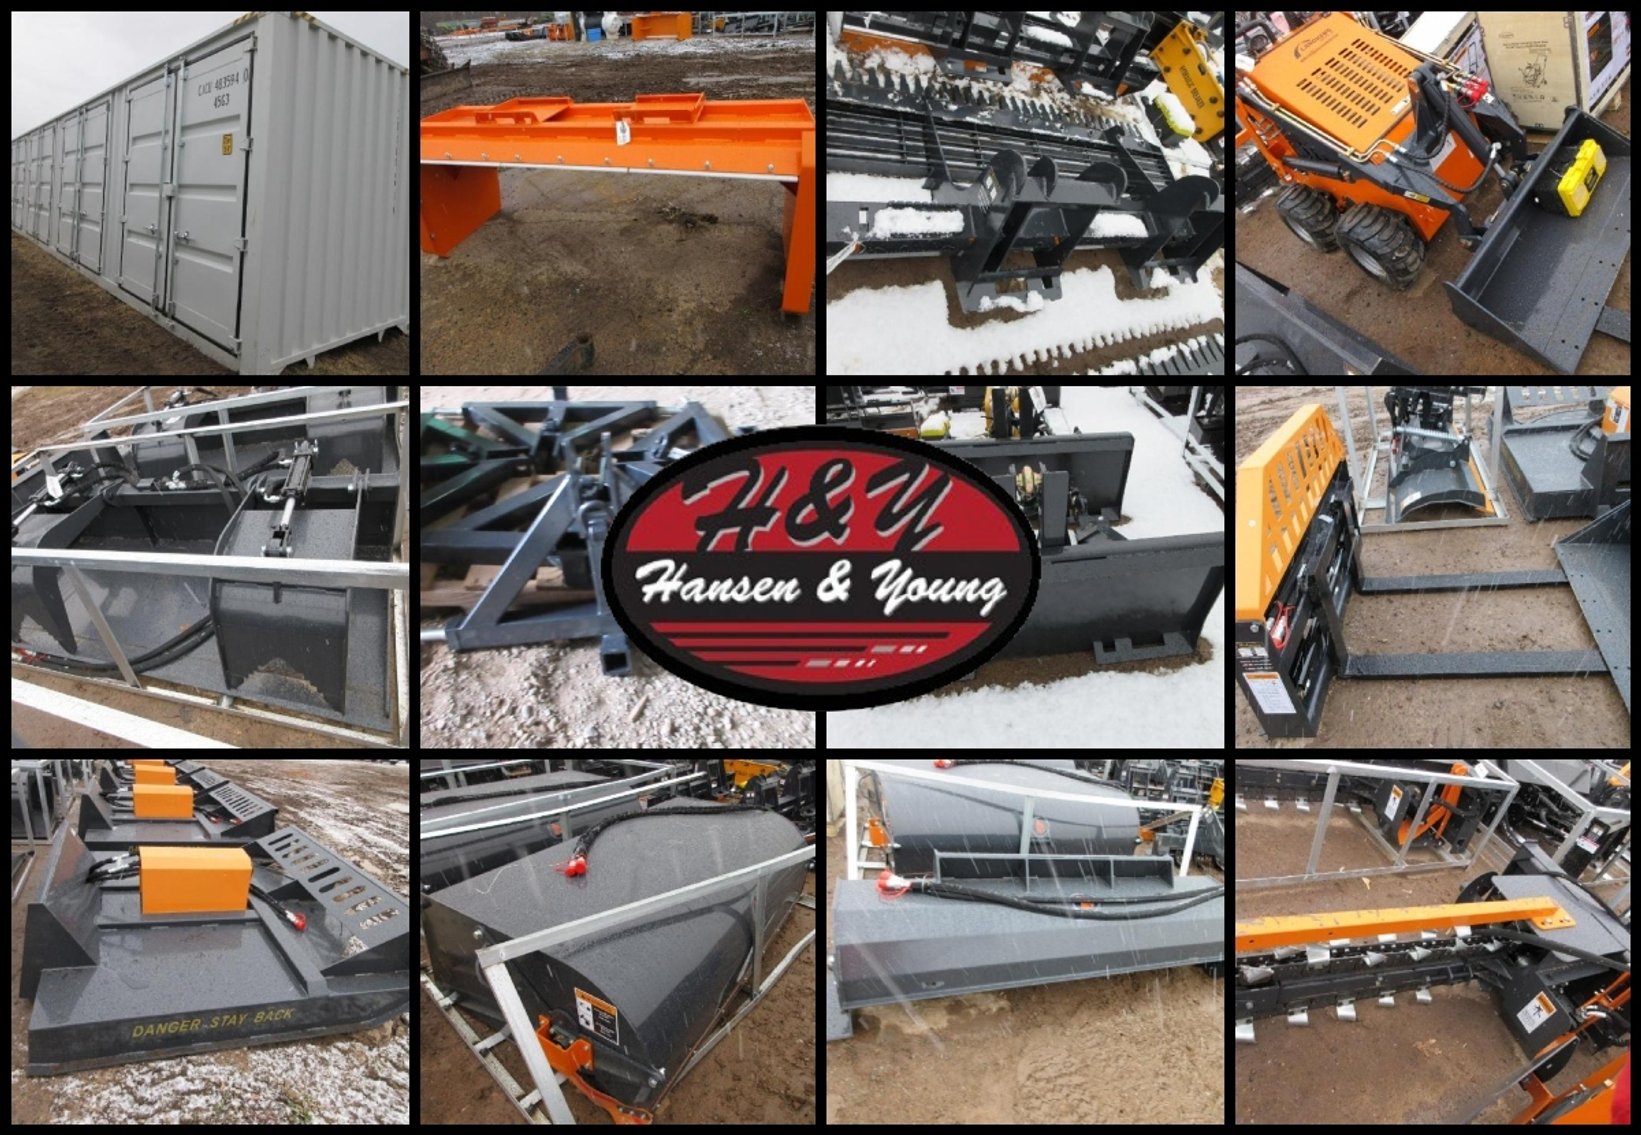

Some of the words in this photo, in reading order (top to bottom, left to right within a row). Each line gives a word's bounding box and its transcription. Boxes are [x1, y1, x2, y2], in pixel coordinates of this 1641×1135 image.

[131, 1018, 202, 1039] DANGER
[209, 1013, 249, 1029] STAY
[253, 1007, 295, 1024] BACK
